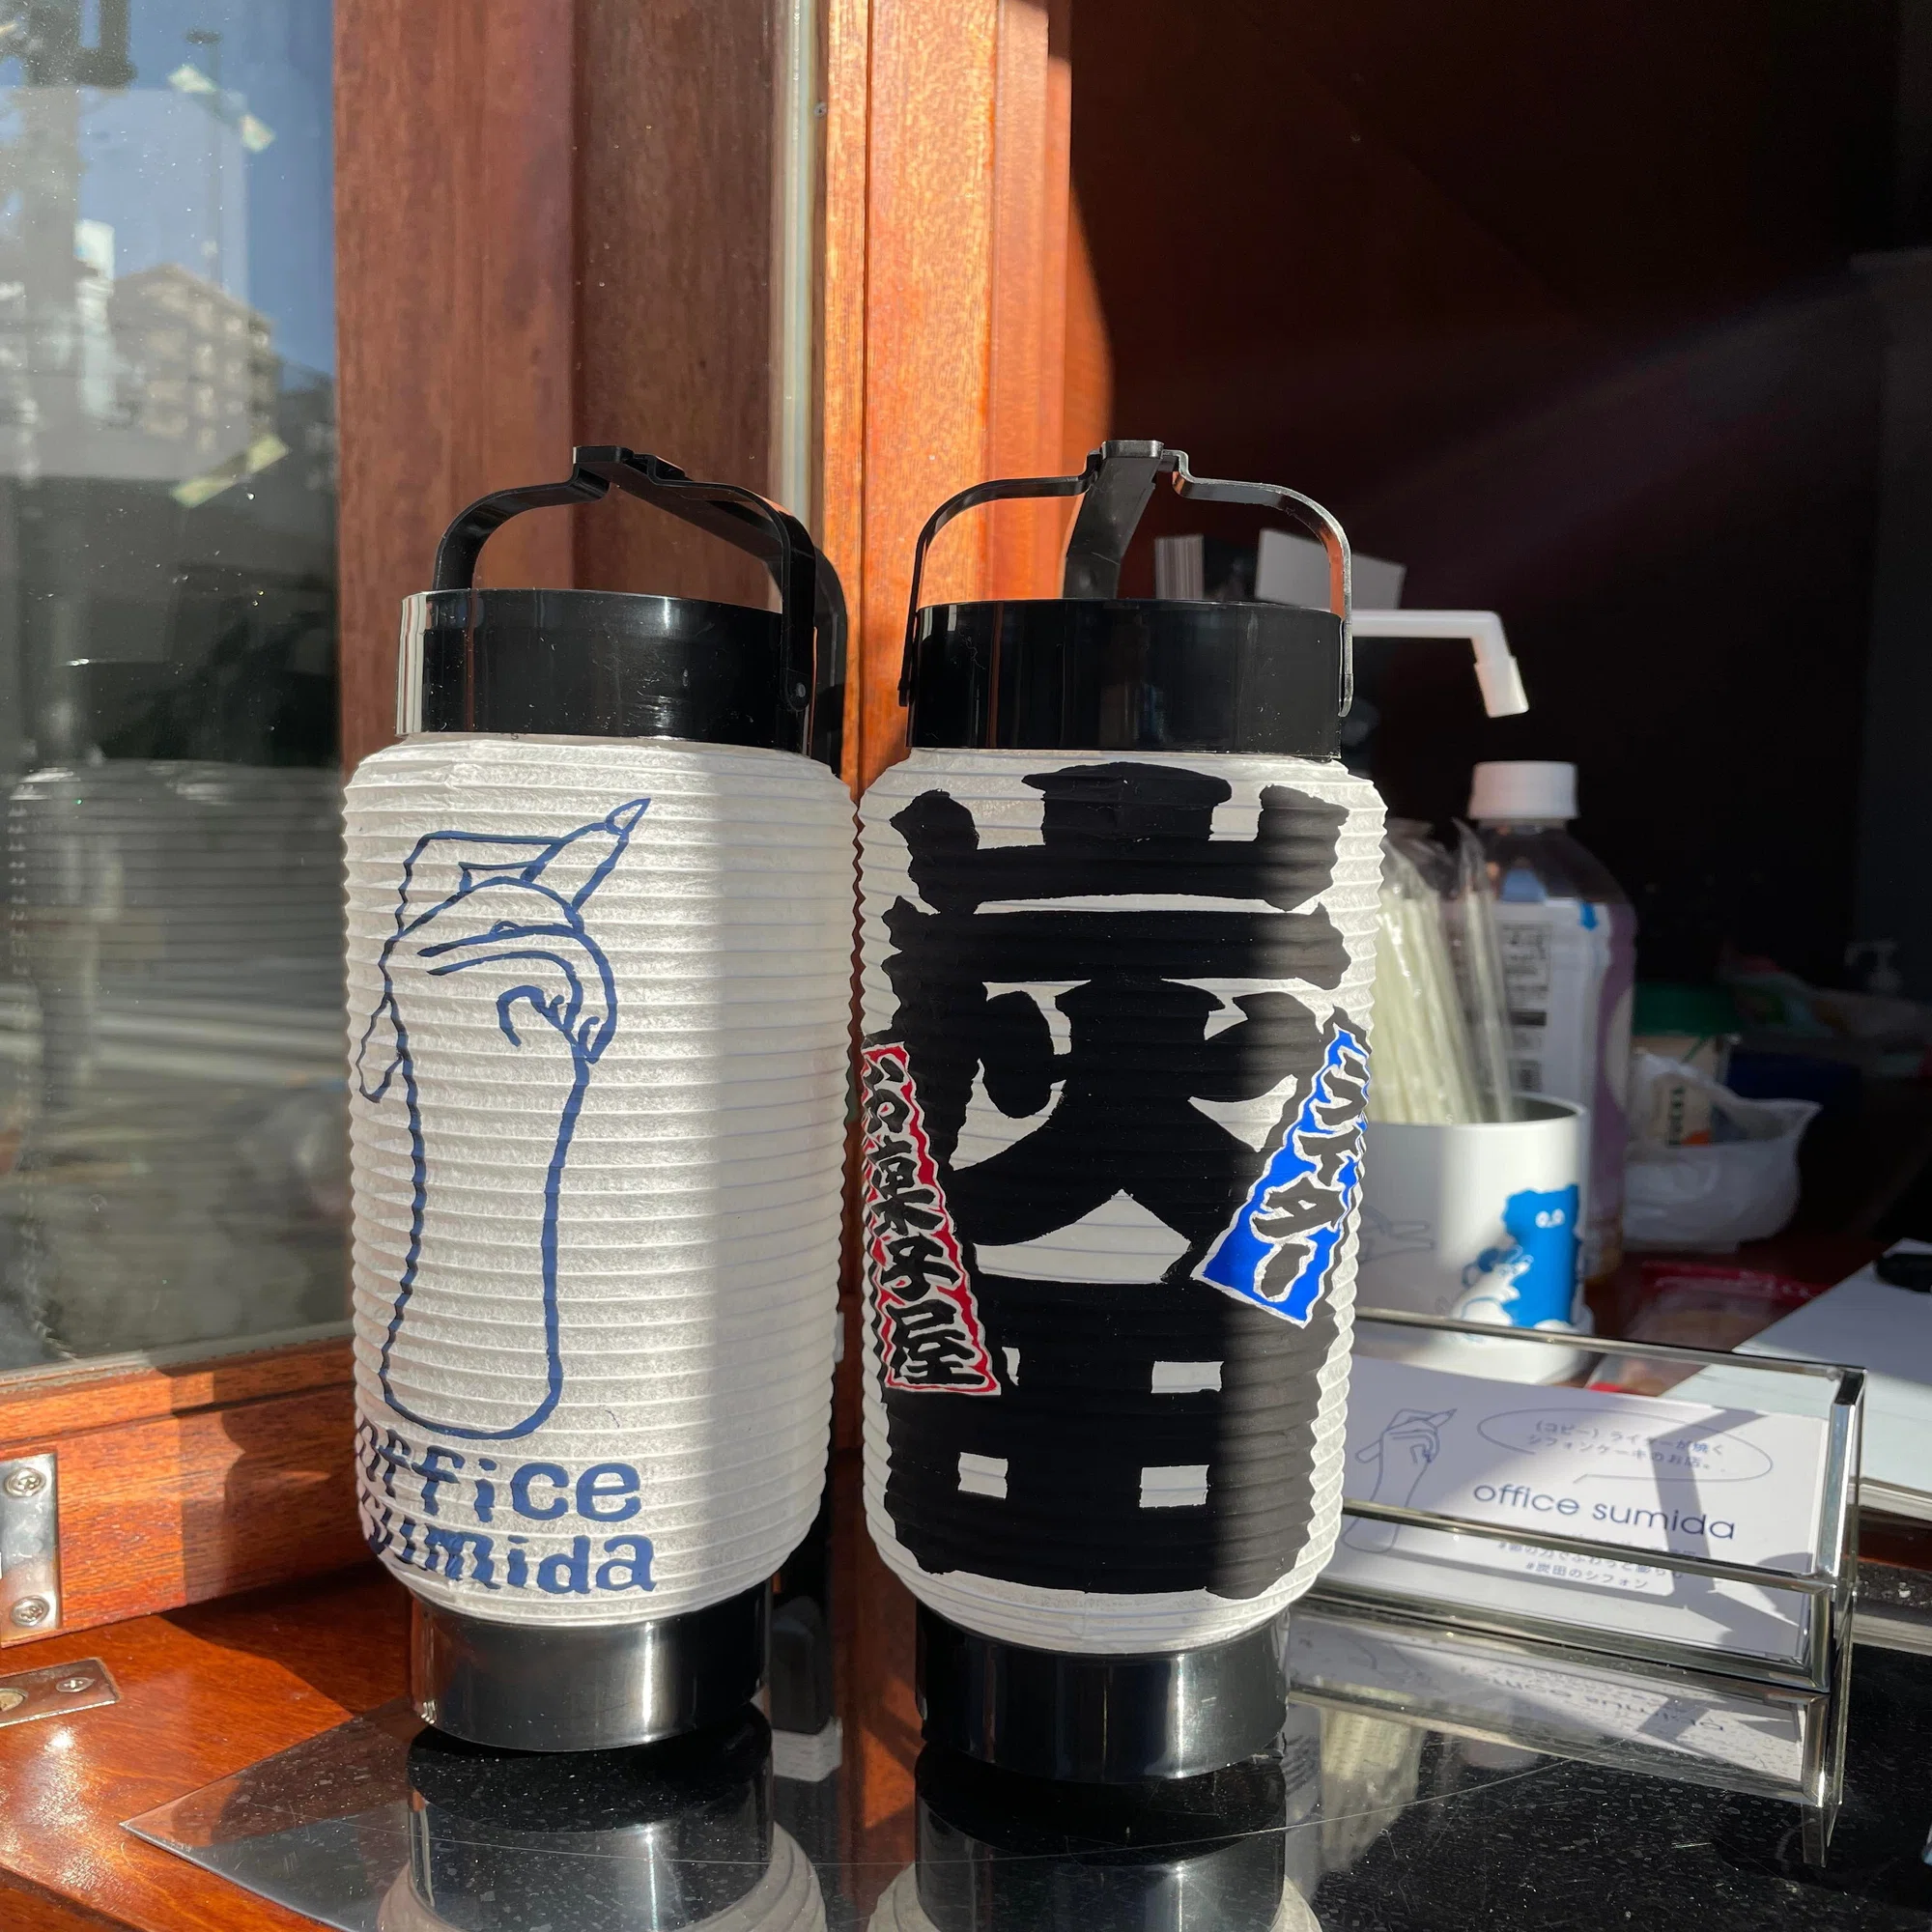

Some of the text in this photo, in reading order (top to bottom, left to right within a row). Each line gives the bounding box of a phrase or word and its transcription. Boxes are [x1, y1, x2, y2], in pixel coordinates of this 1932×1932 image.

[358, 1418, 641, 1522] office
[1473, 1484, 1735, 1540] office sumida
